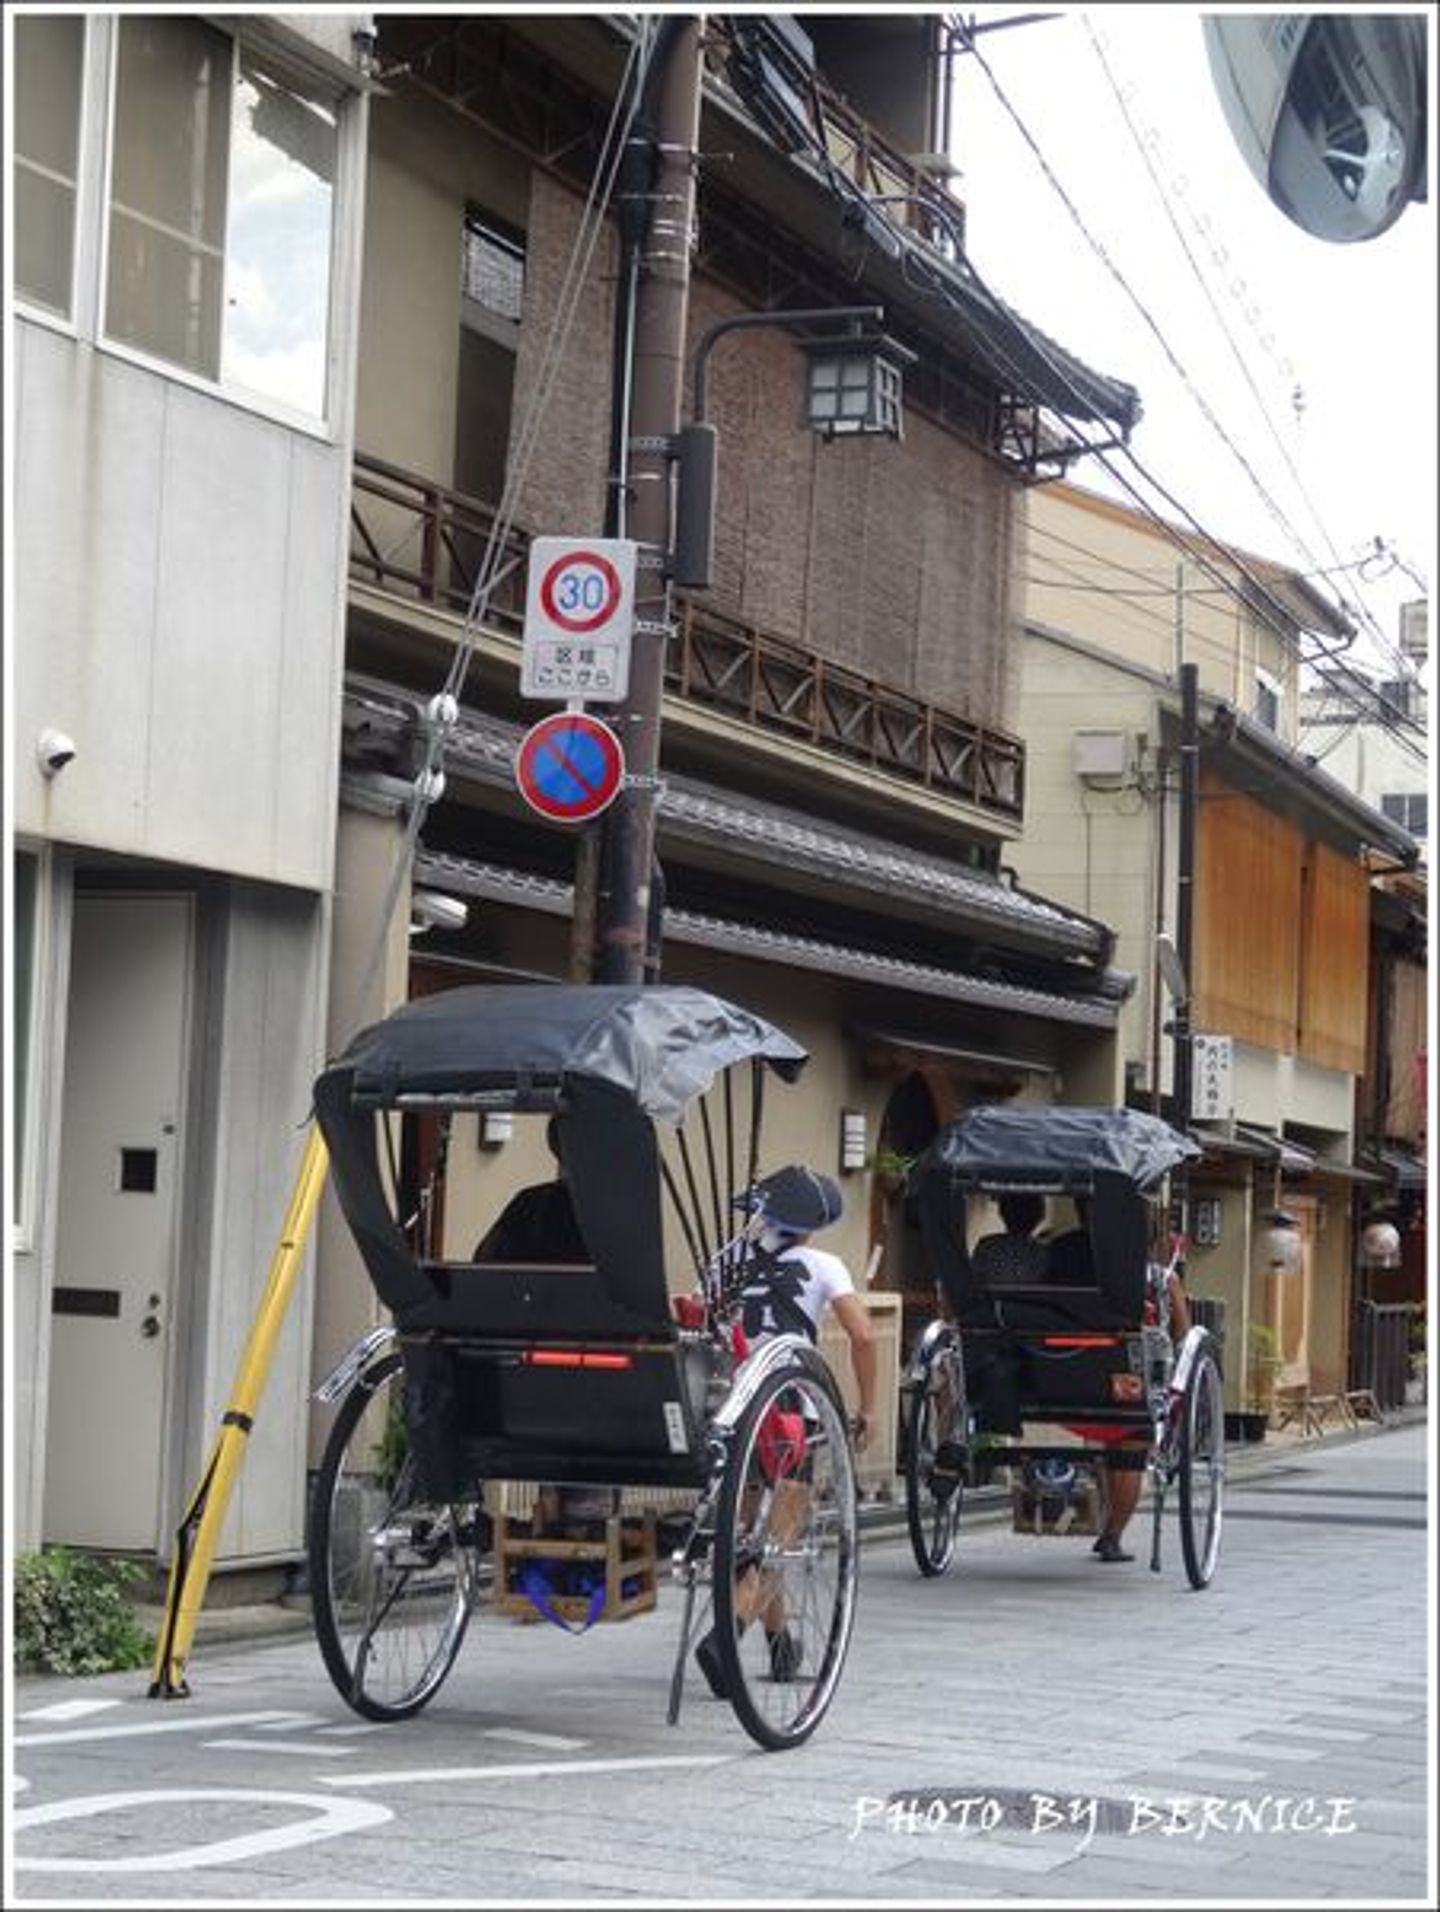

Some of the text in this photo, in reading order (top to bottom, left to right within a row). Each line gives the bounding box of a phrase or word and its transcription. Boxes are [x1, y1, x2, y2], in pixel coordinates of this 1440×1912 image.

[560, 574, 603, 610] 30
[538, 666, 610, 687] ここから
